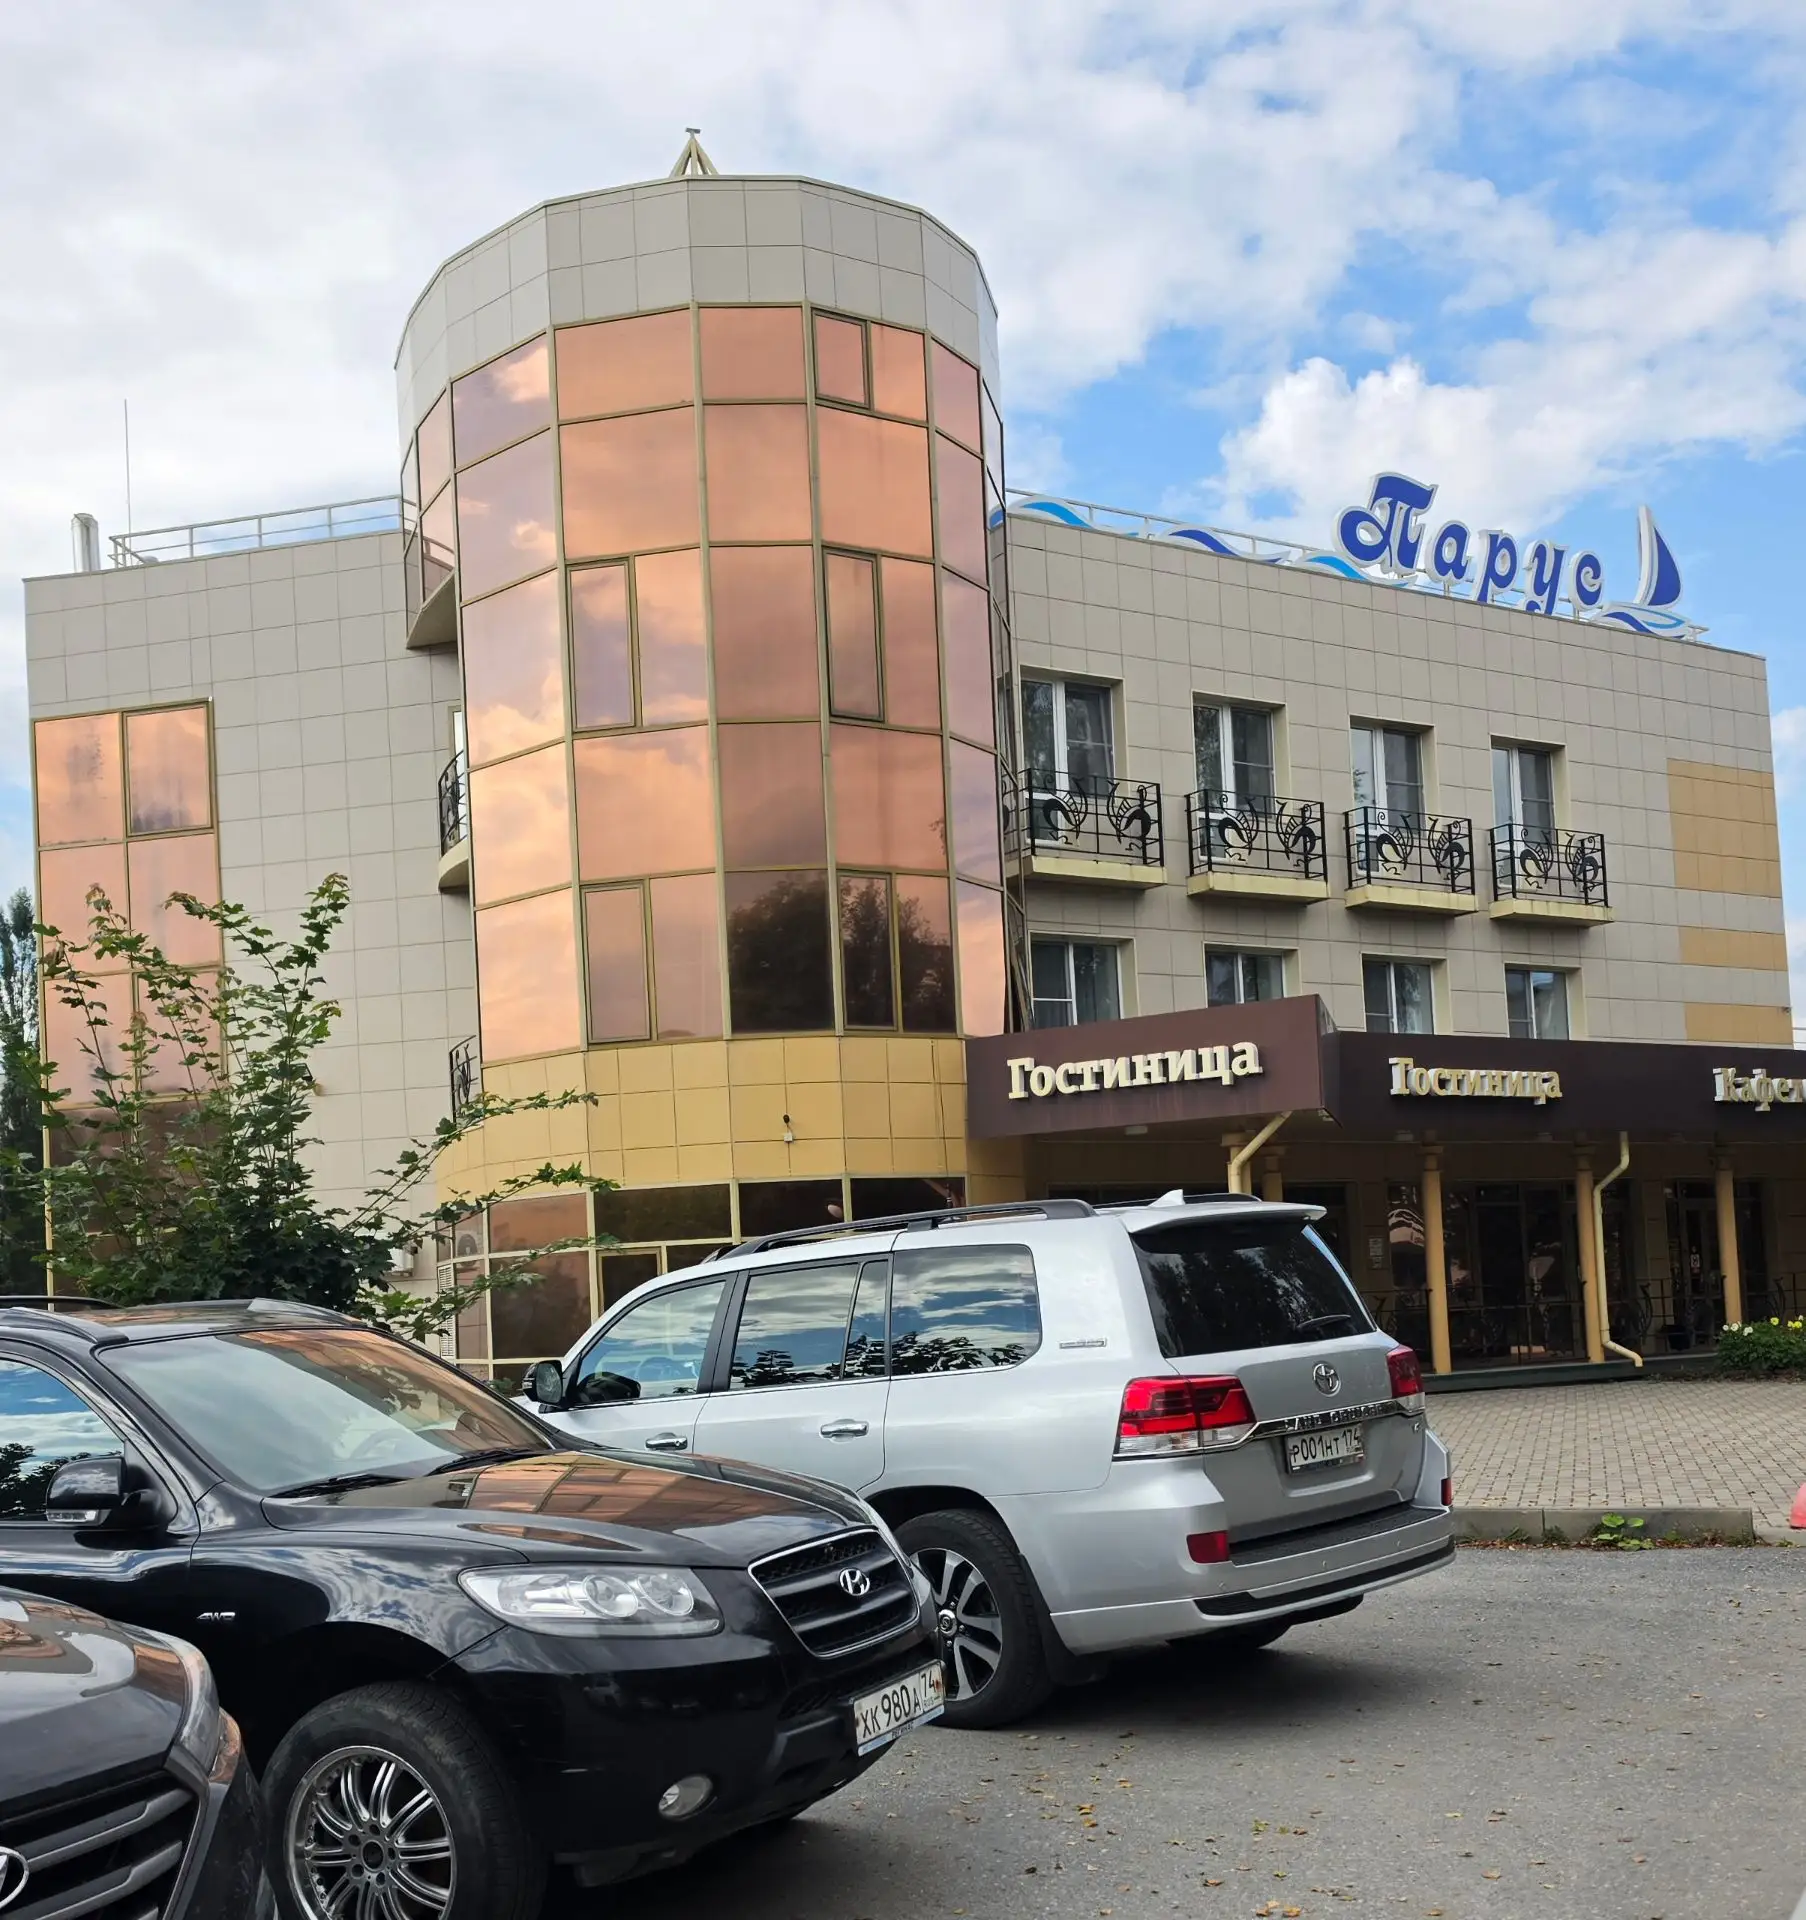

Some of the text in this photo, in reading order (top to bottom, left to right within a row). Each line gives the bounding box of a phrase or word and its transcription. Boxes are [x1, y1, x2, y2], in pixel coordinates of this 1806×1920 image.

[1333, 471, 1604, 615] Парус
[1007, 1041, 1263, 1100] Гостиница
[1388, 1057, 1562, 1105] Гостиница
